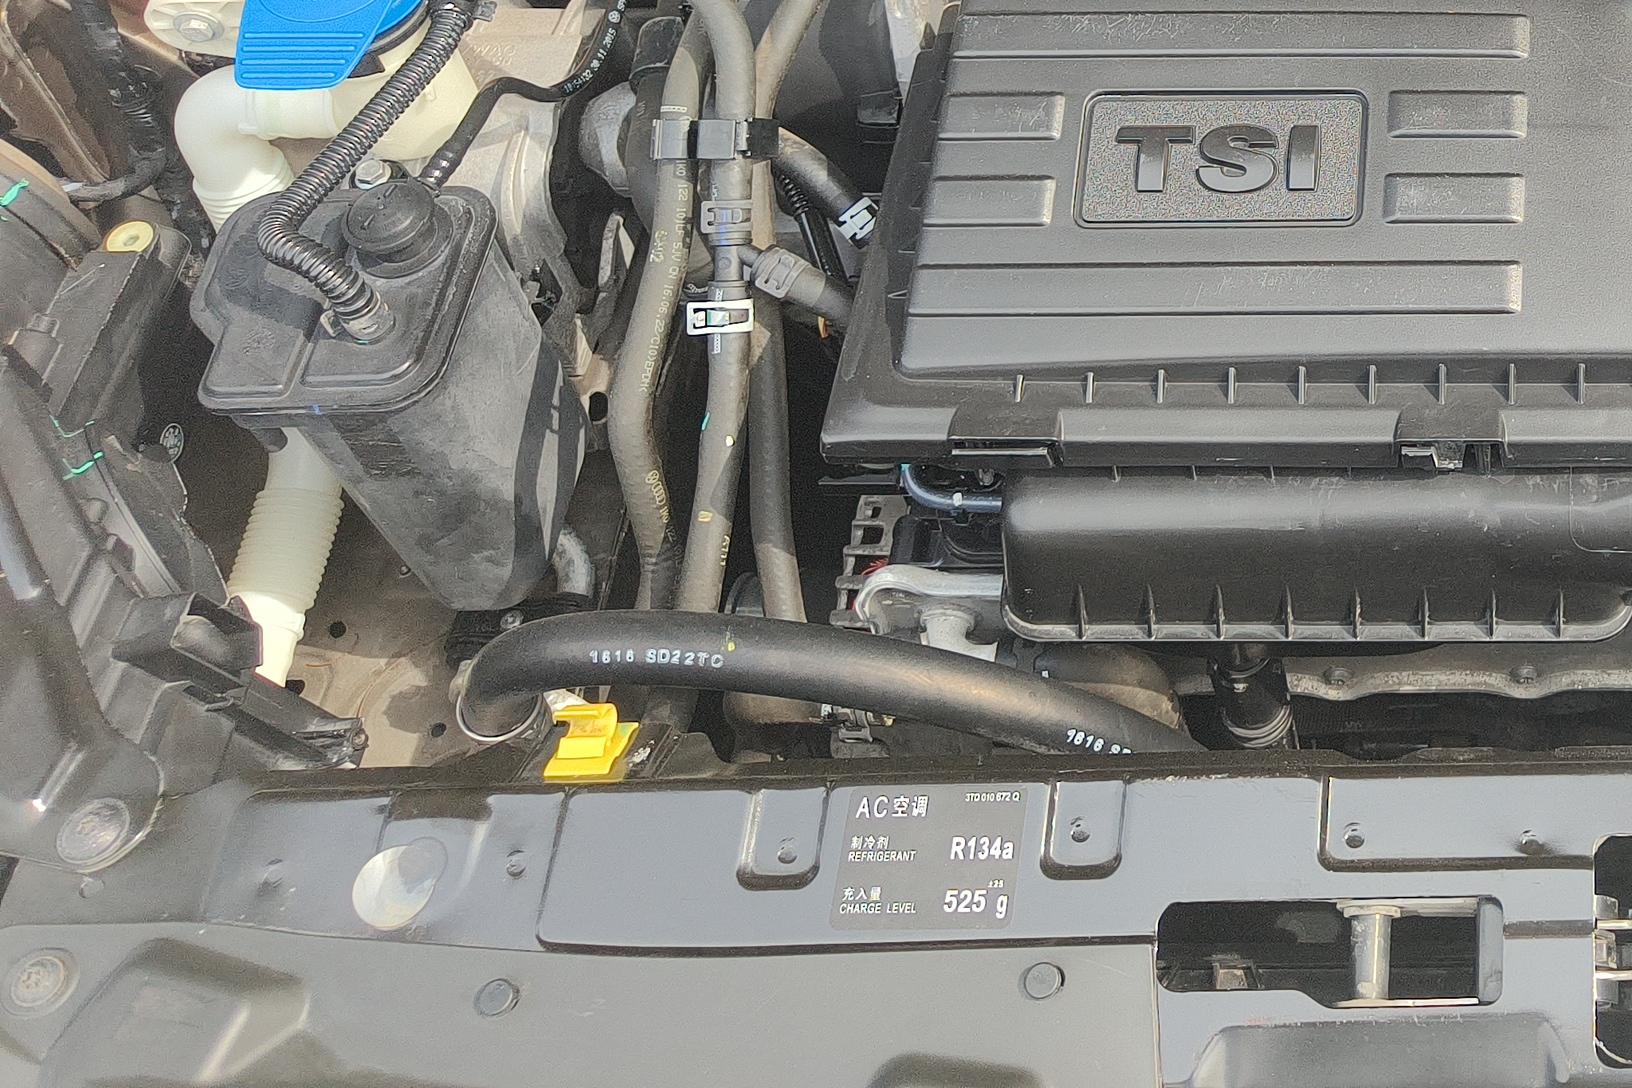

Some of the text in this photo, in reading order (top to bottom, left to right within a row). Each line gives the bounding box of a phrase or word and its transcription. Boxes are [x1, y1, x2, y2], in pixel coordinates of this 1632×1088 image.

[1115, 124, 1320, 193] TSI
[850, 835, 890, 850] 制冷剂
[950, 836, 1014, 860] R134a
[848, 850, 917, 862] REFRIGERANT
[842, 886, 882, 901] 充入量
[839, 902, 917, 915] CHARGE LEVEL
[943, 889, 1009, 919] 525 g
